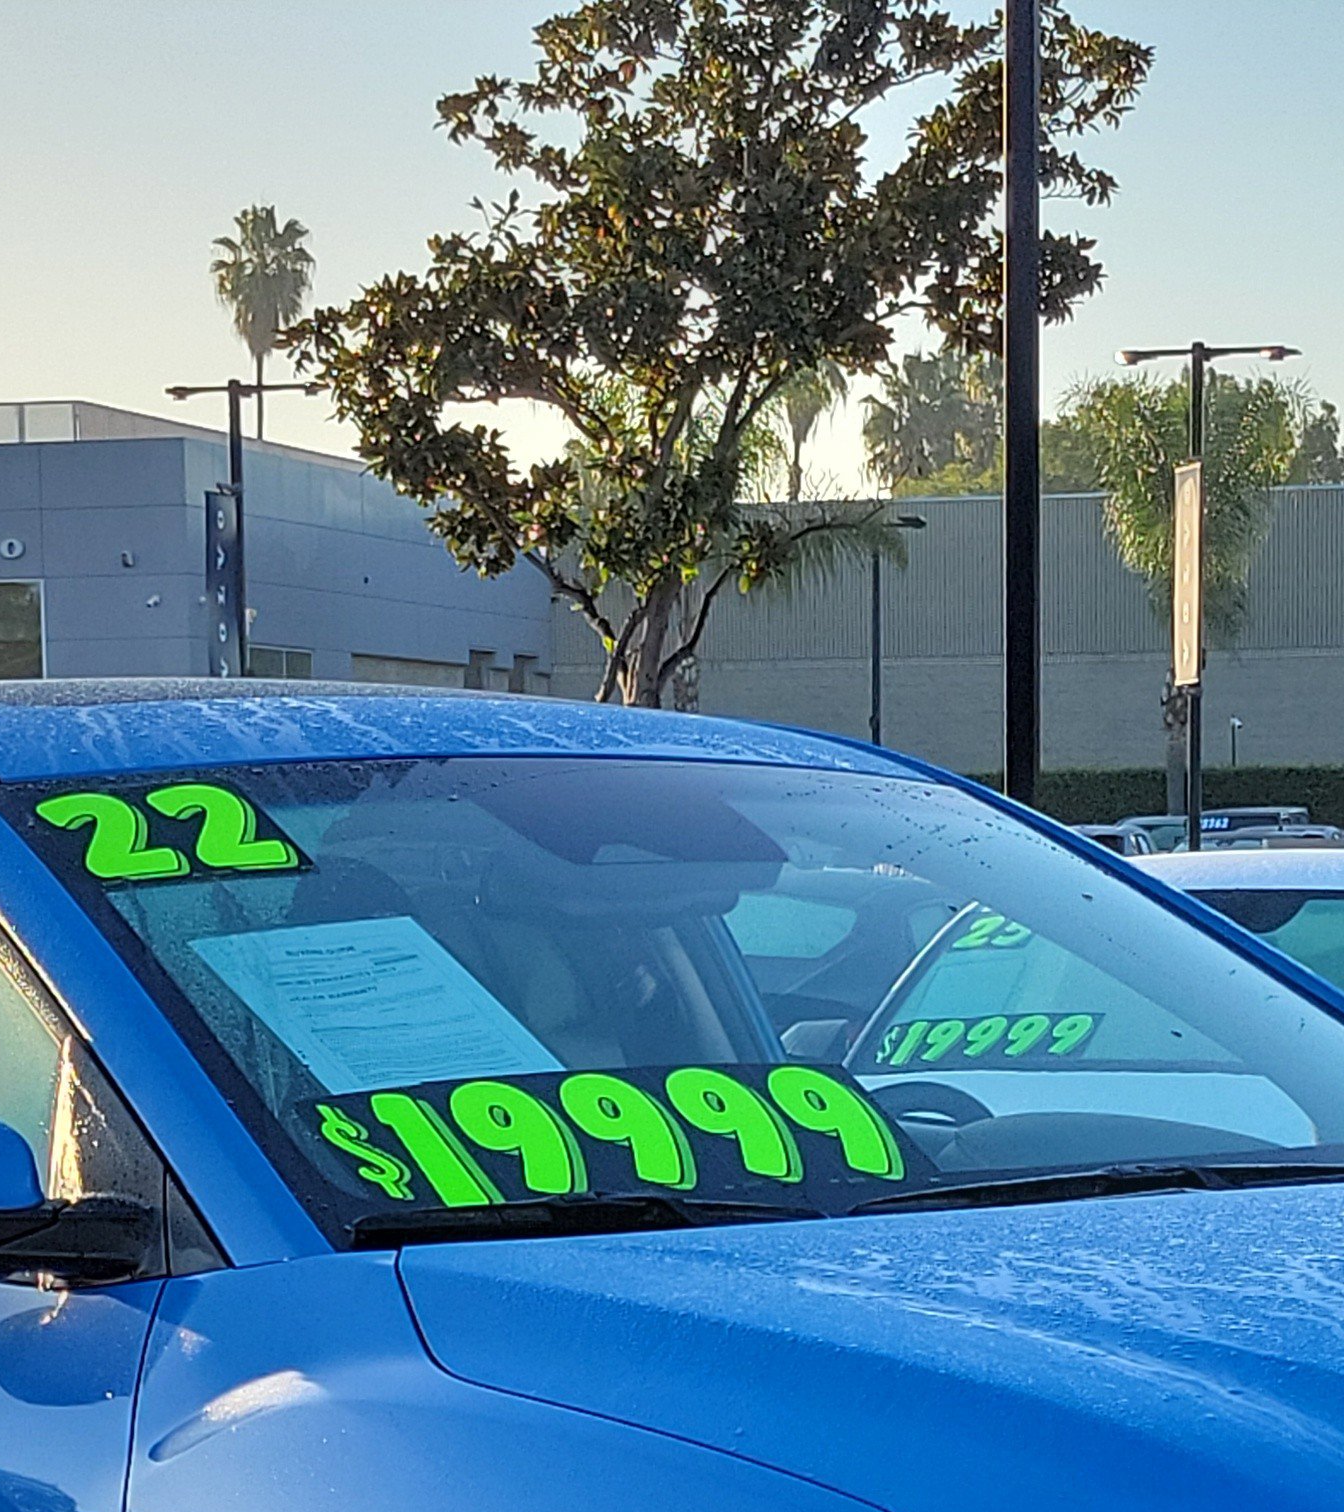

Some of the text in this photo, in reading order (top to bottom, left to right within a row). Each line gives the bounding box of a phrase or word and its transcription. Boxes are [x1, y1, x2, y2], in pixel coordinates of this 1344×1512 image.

[216, 510, 229, 678] VOLVO
[36, 784, 299, 880] 22
[875, 1014, 1094, 1067] $19999
[316, 1066, 905, 1207] $19999
